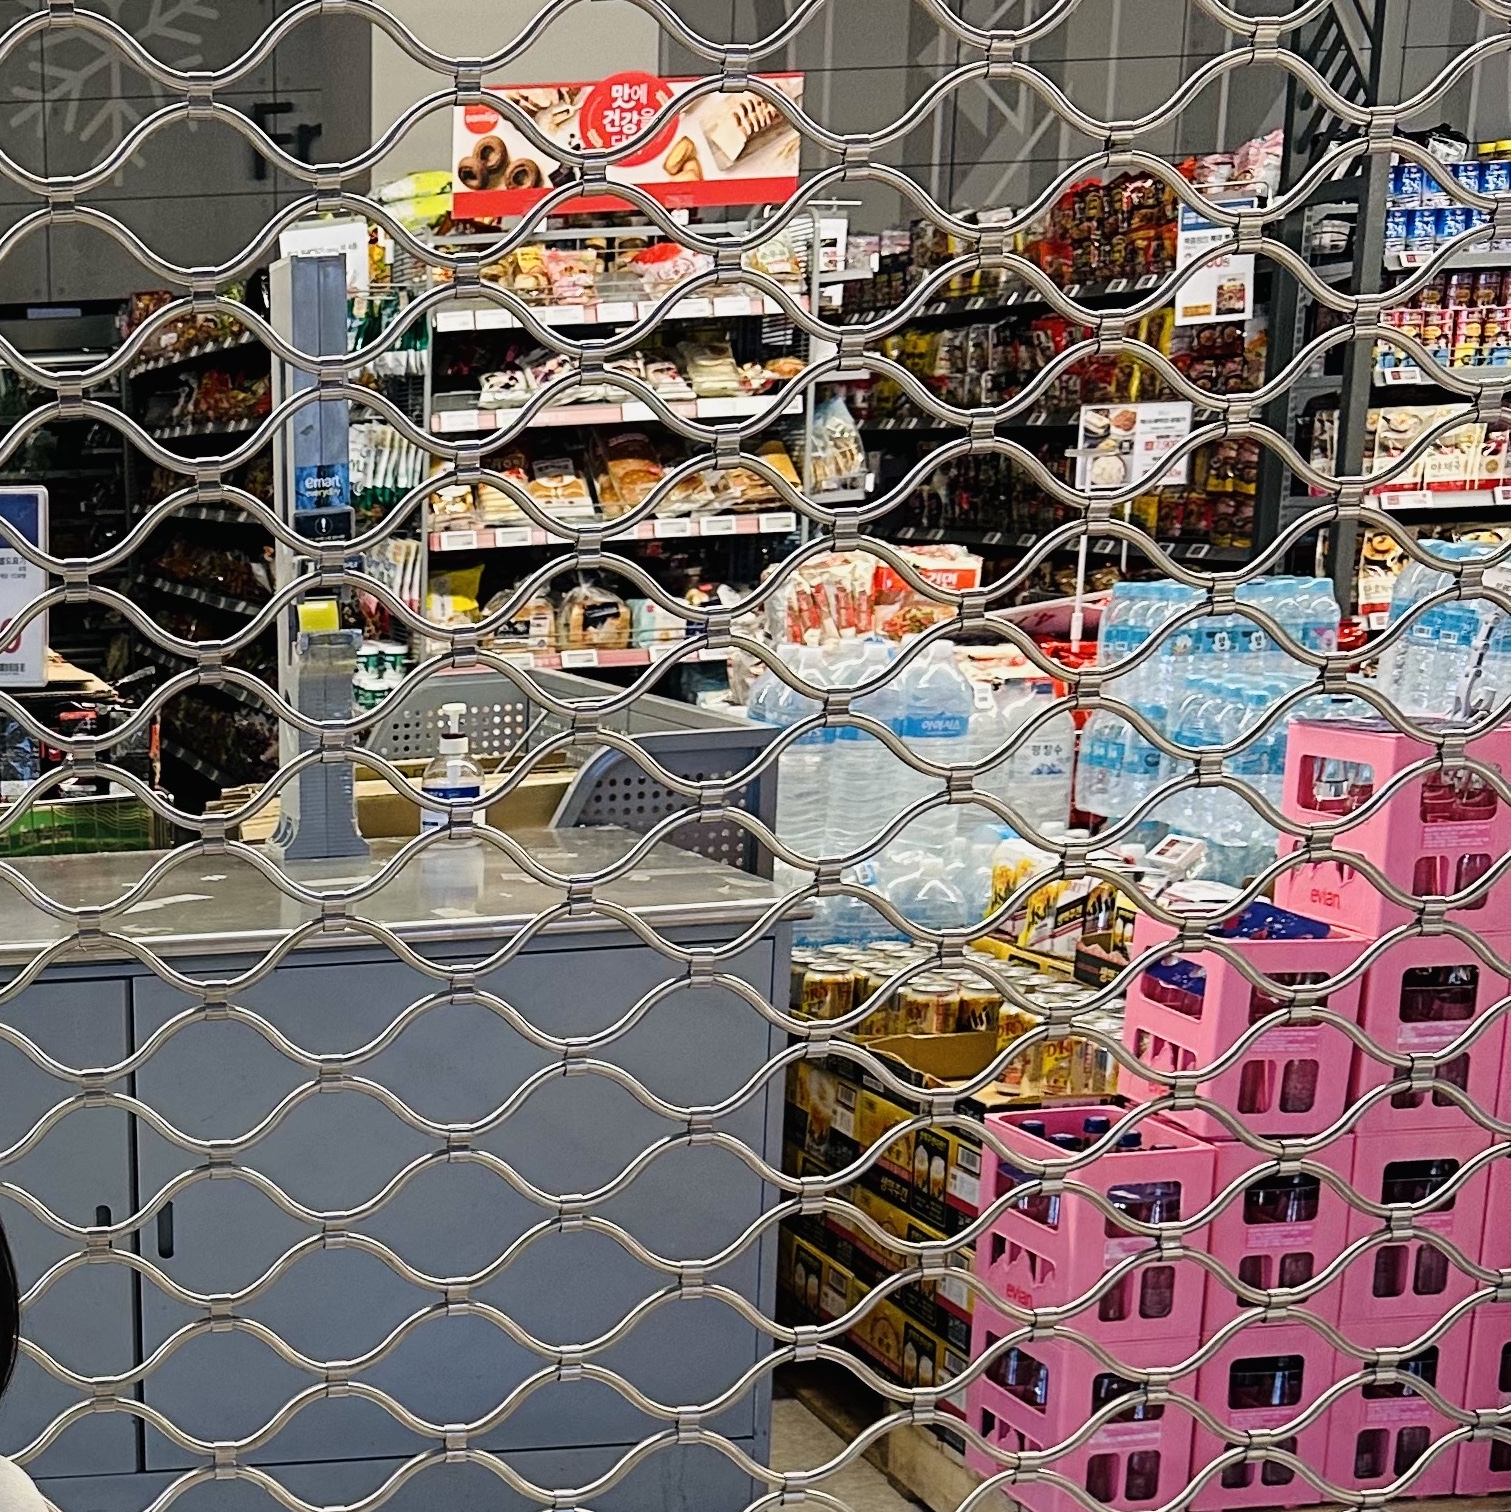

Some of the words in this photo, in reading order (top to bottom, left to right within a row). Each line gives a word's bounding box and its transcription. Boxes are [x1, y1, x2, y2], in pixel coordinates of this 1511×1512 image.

[610, 82, 648, 107] 맛에
[601, 107, 656, 135] 건강을
[304, 474, 342, 489] emart
[920, 718, 962, 732] 아이시스
[1031, 743, 1063, 757] 평창수
[1310, 888, 1341, 909] evian
[1006, 1282, 1034, 1310] evian
